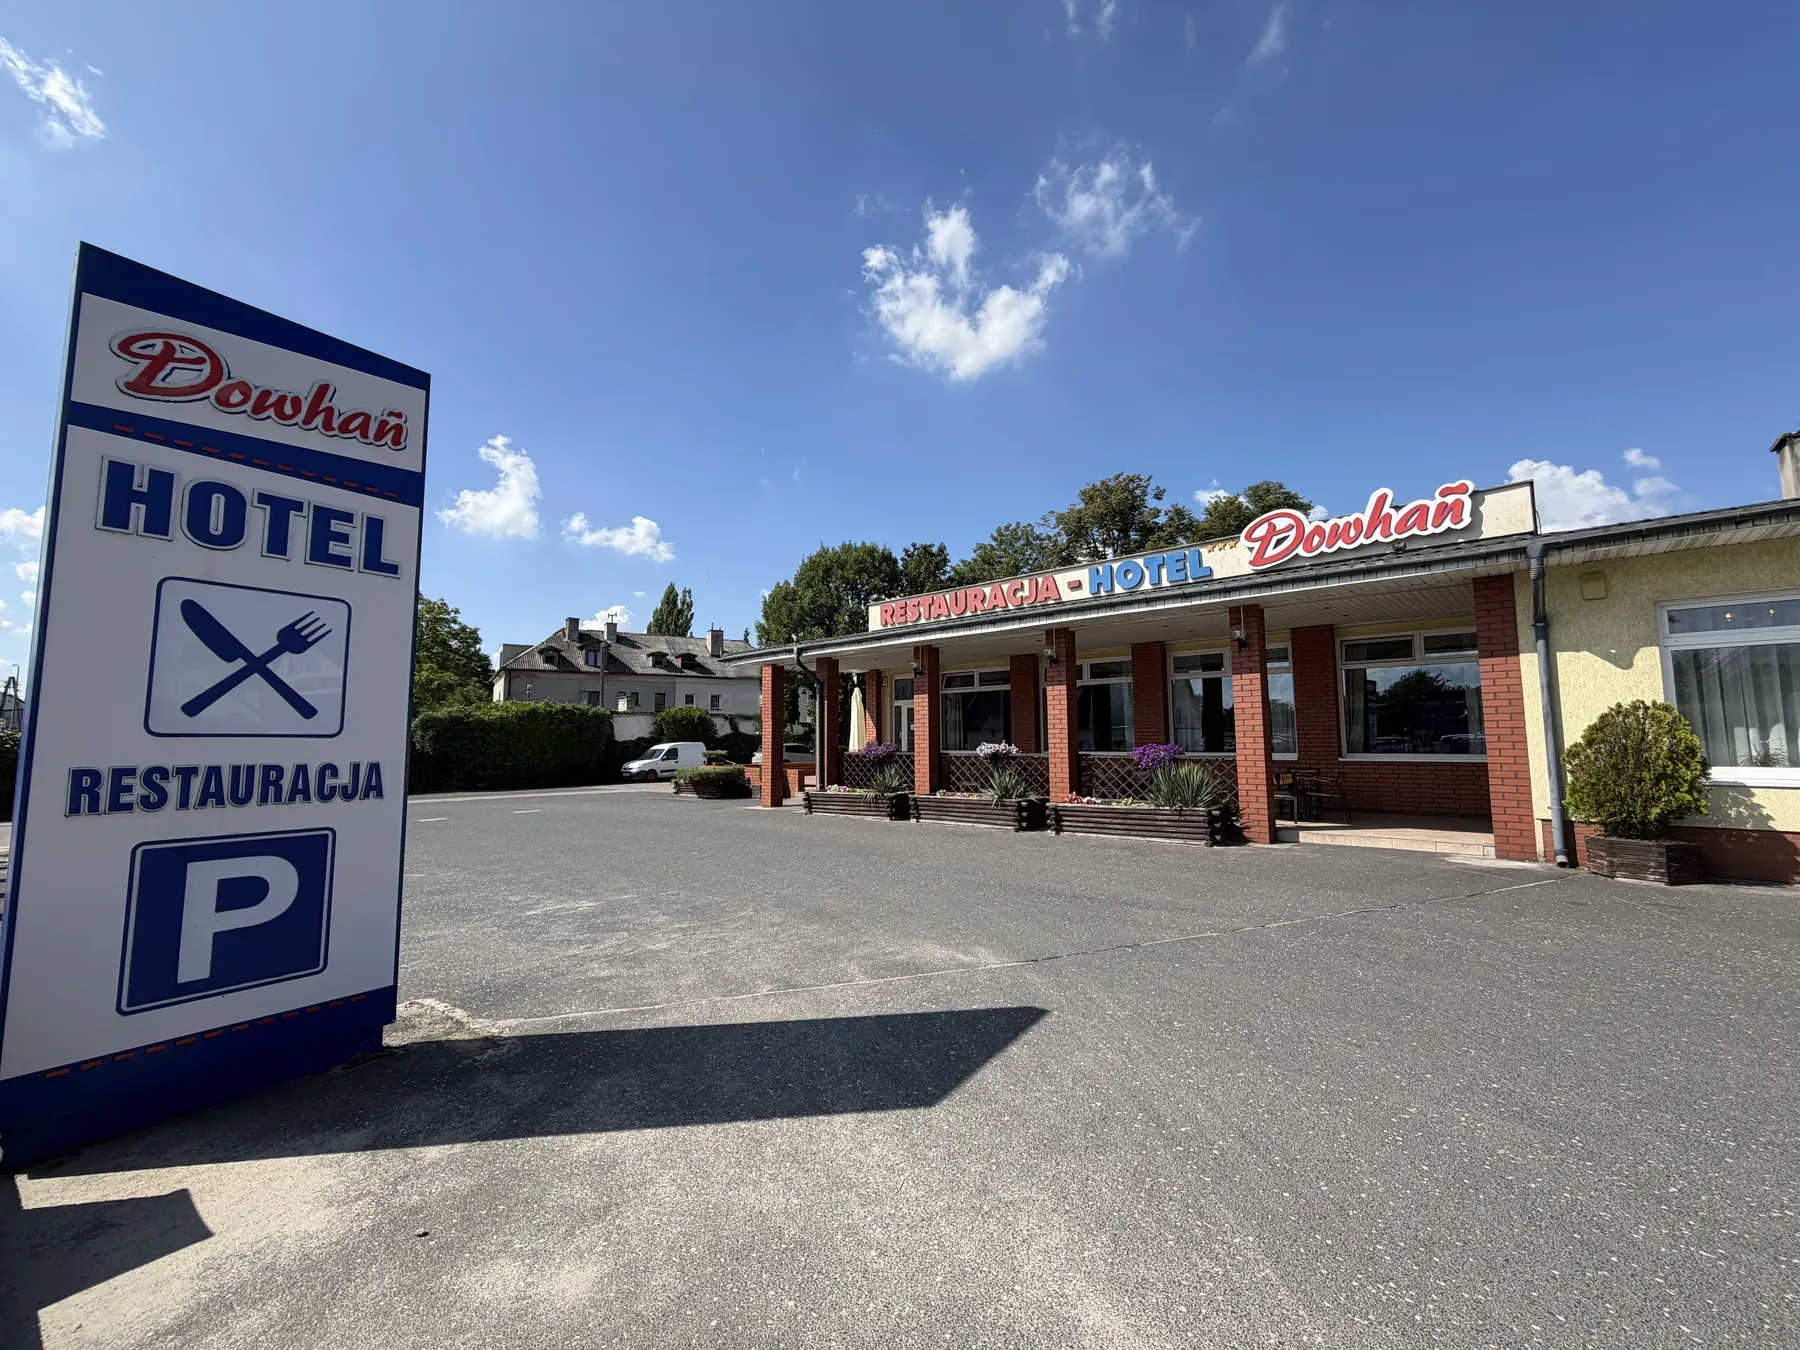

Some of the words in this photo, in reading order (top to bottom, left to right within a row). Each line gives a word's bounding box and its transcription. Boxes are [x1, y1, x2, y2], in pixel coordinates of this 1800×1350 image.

[98, 457, 400, 578] HOTEL
[879, 574, 1061, 626] RESTAURACJA
[1088, 548, 1212, 595] HOTEL
[66, 761, 385, 816] RESTAURACJA
[177, 855, 299, 984] P
